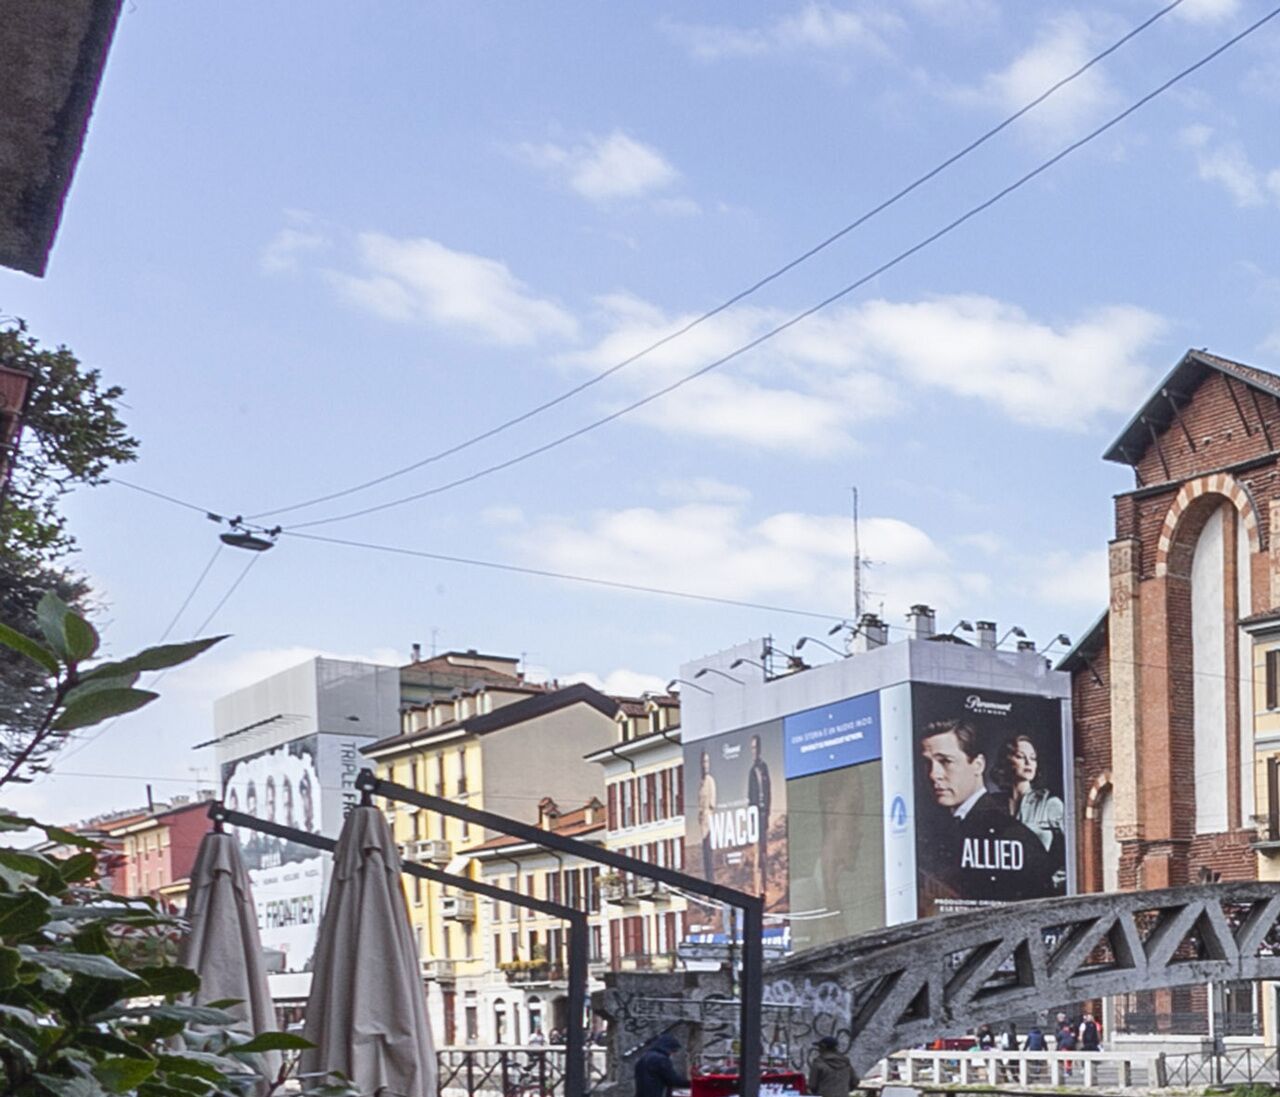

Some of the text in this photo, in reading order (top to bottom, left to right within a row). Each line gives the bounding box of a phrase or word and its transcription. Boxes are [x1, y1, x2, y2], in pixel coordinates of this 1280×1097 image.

[340, 742, 358, 789] TRIPLE
[708, 805, 760, 850] WACO
[961, 837, 1024, 871] ALLIED
